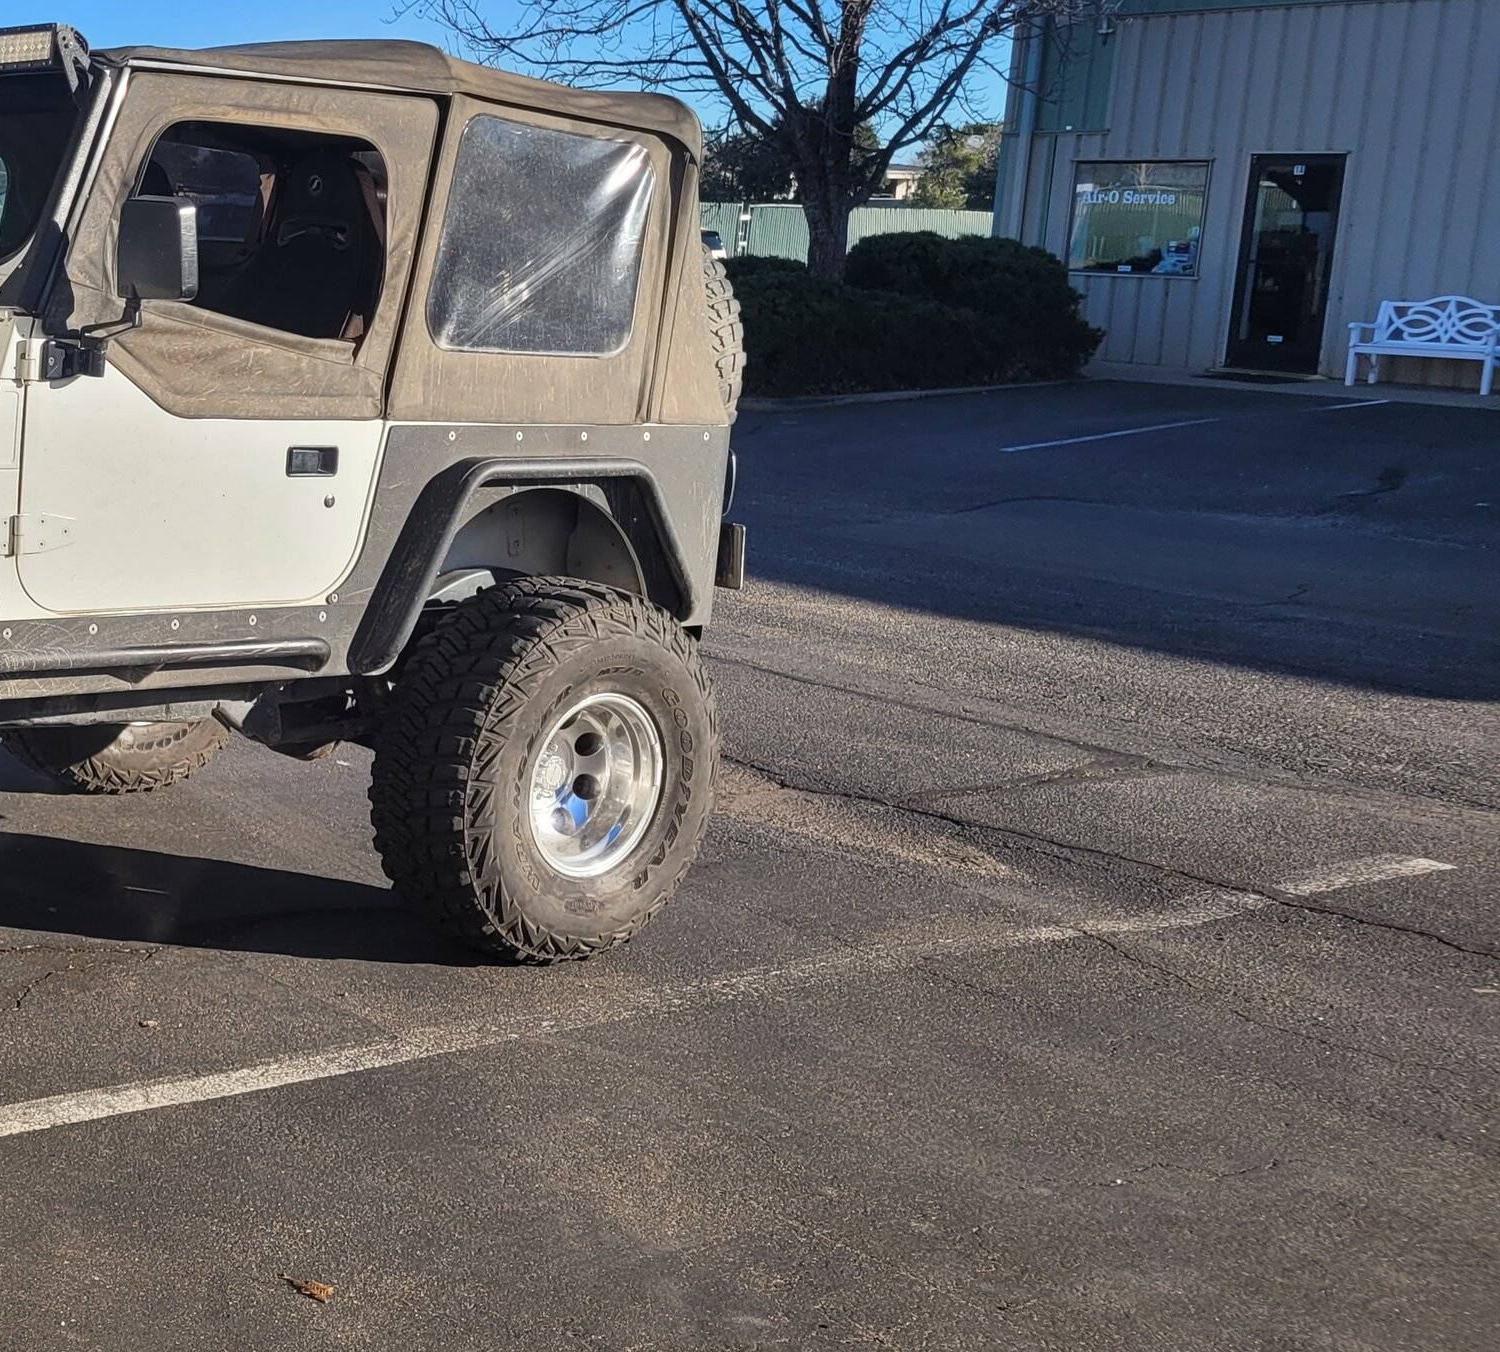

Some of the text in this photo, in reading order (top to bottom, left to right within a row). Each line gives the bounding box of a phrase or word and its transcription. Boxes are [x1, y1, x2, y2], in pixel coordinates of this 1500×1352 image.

[1082, 190, 1175, 204] Air-O Service
[632, 687, 694, 891] GOODYEAR
